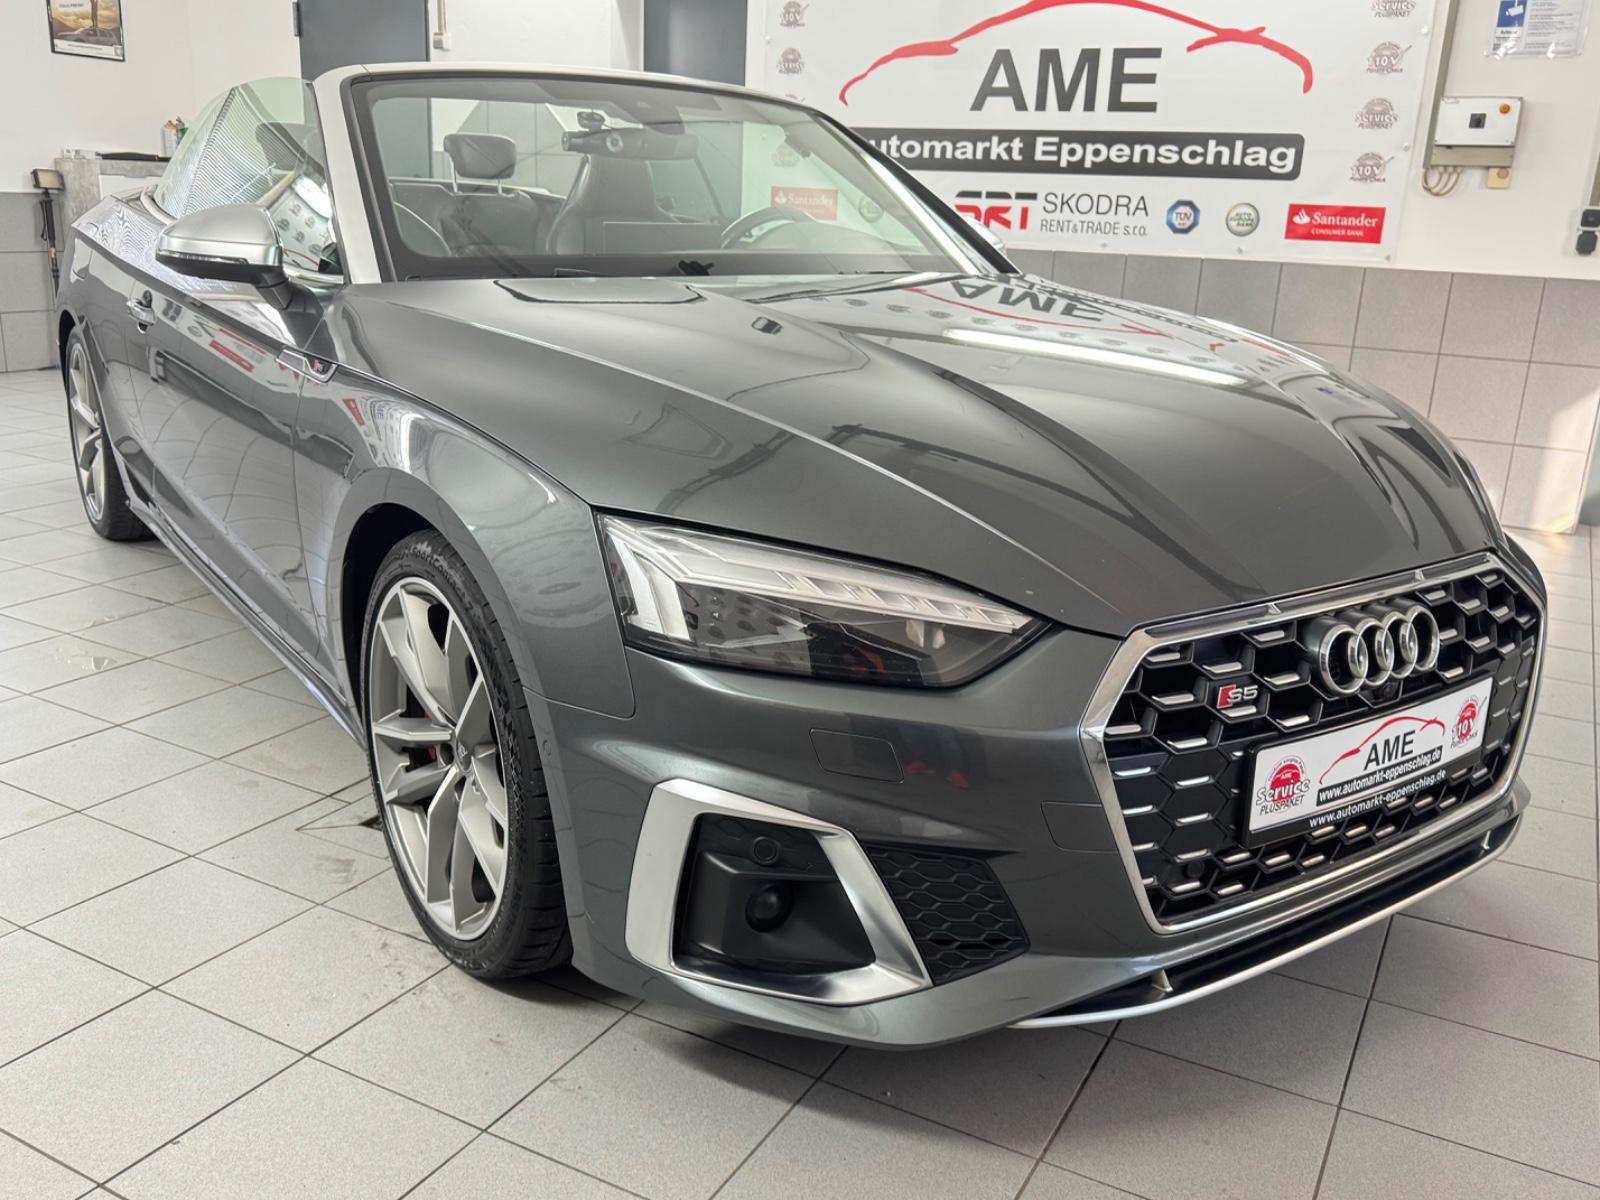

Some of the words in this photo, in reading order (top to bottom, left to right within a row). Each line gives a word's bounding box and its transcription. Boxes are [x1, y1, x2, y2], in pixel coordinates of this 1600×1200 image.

[970, 47, 1162, 113] AME
[868, 135, 1023, 161] utomarkt
[1034, 136, 1296, 173] Eppenschlag
[1043, 192, 1149, 217] SKODRA
[1312, 211, 1378, 228] Santander
[1040, 219, 1120, 235] RENT&TRADE
[1226, 684, 1259, 702] S5
[1364, 730, 1415, 770] AME
[1256, 773, 1310, 806] Service
[1319, 748, 1442, 801] www.automarkt-eppenschlag.de
[1309, 769, 1447, 828] www.automarkt-eppenschlag.de
